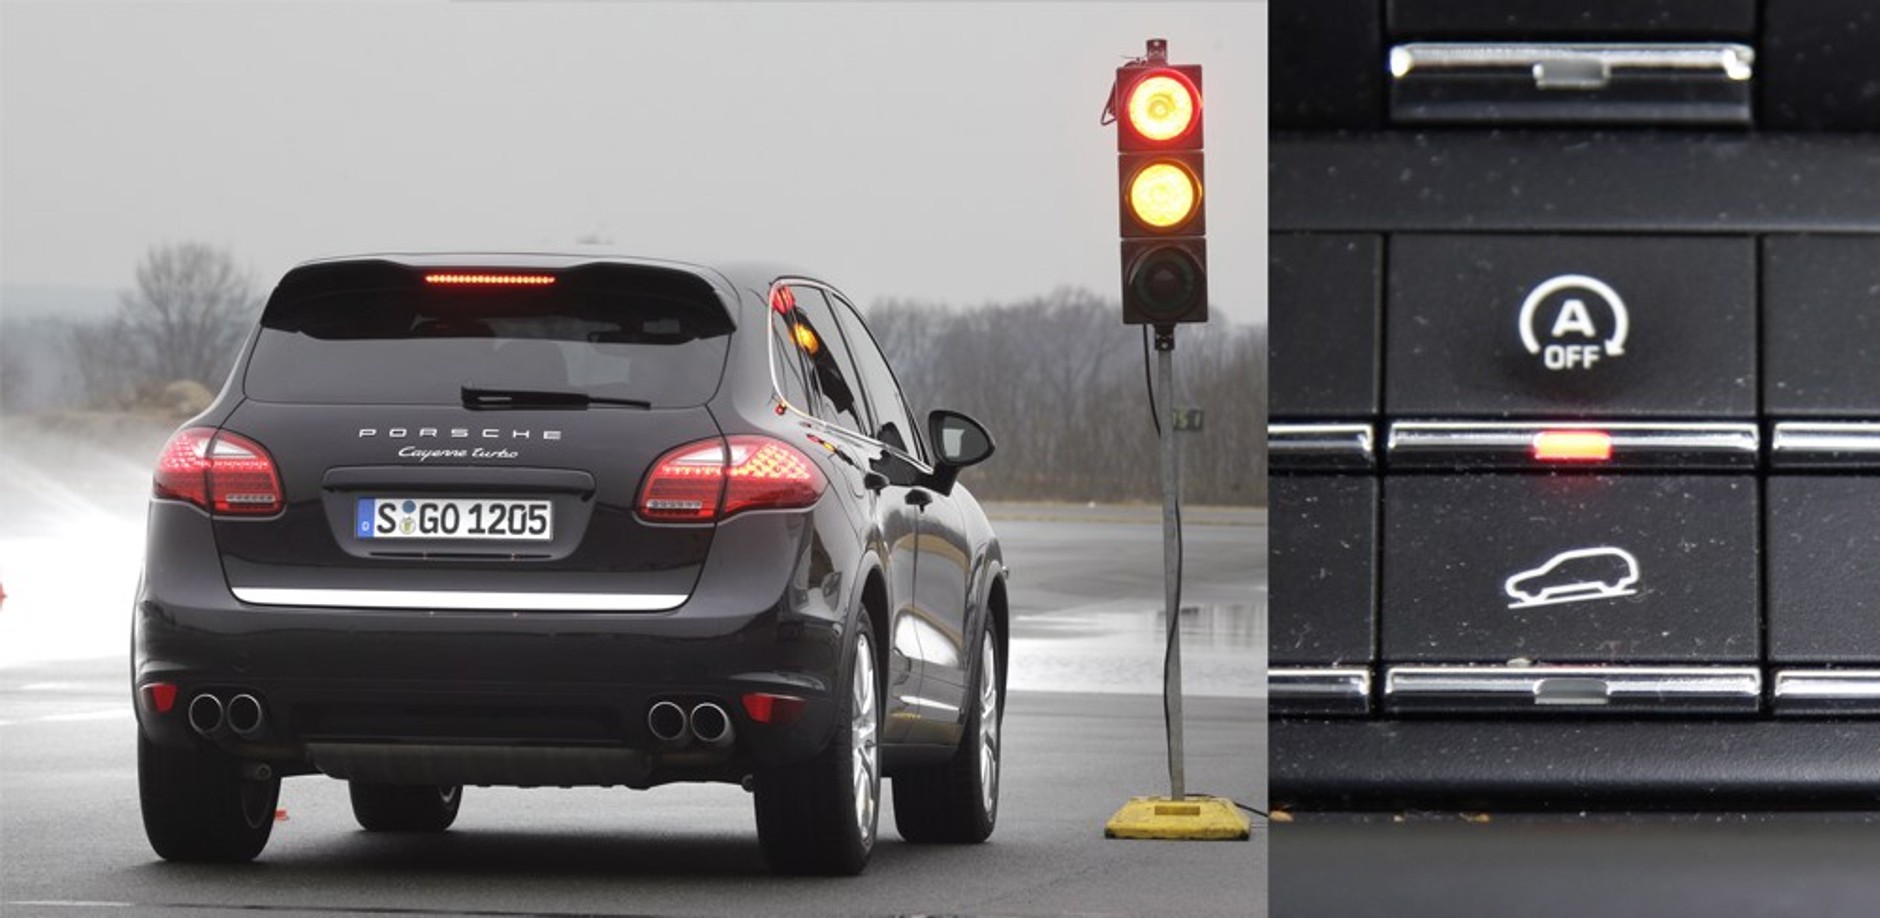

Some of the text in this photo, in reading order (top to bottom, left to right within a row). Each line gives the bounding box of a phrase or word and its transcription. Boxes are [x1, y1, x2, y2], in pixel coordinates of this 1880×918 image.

[1551, 299, 1596, 338] A
[1544, 345, 1601, 370] OFF
[359, 428, 562, 440] PORSCHE
[398, 446, 518, 461] Cayenne turbo
[377, 503, 548, 535] S GO 1205
